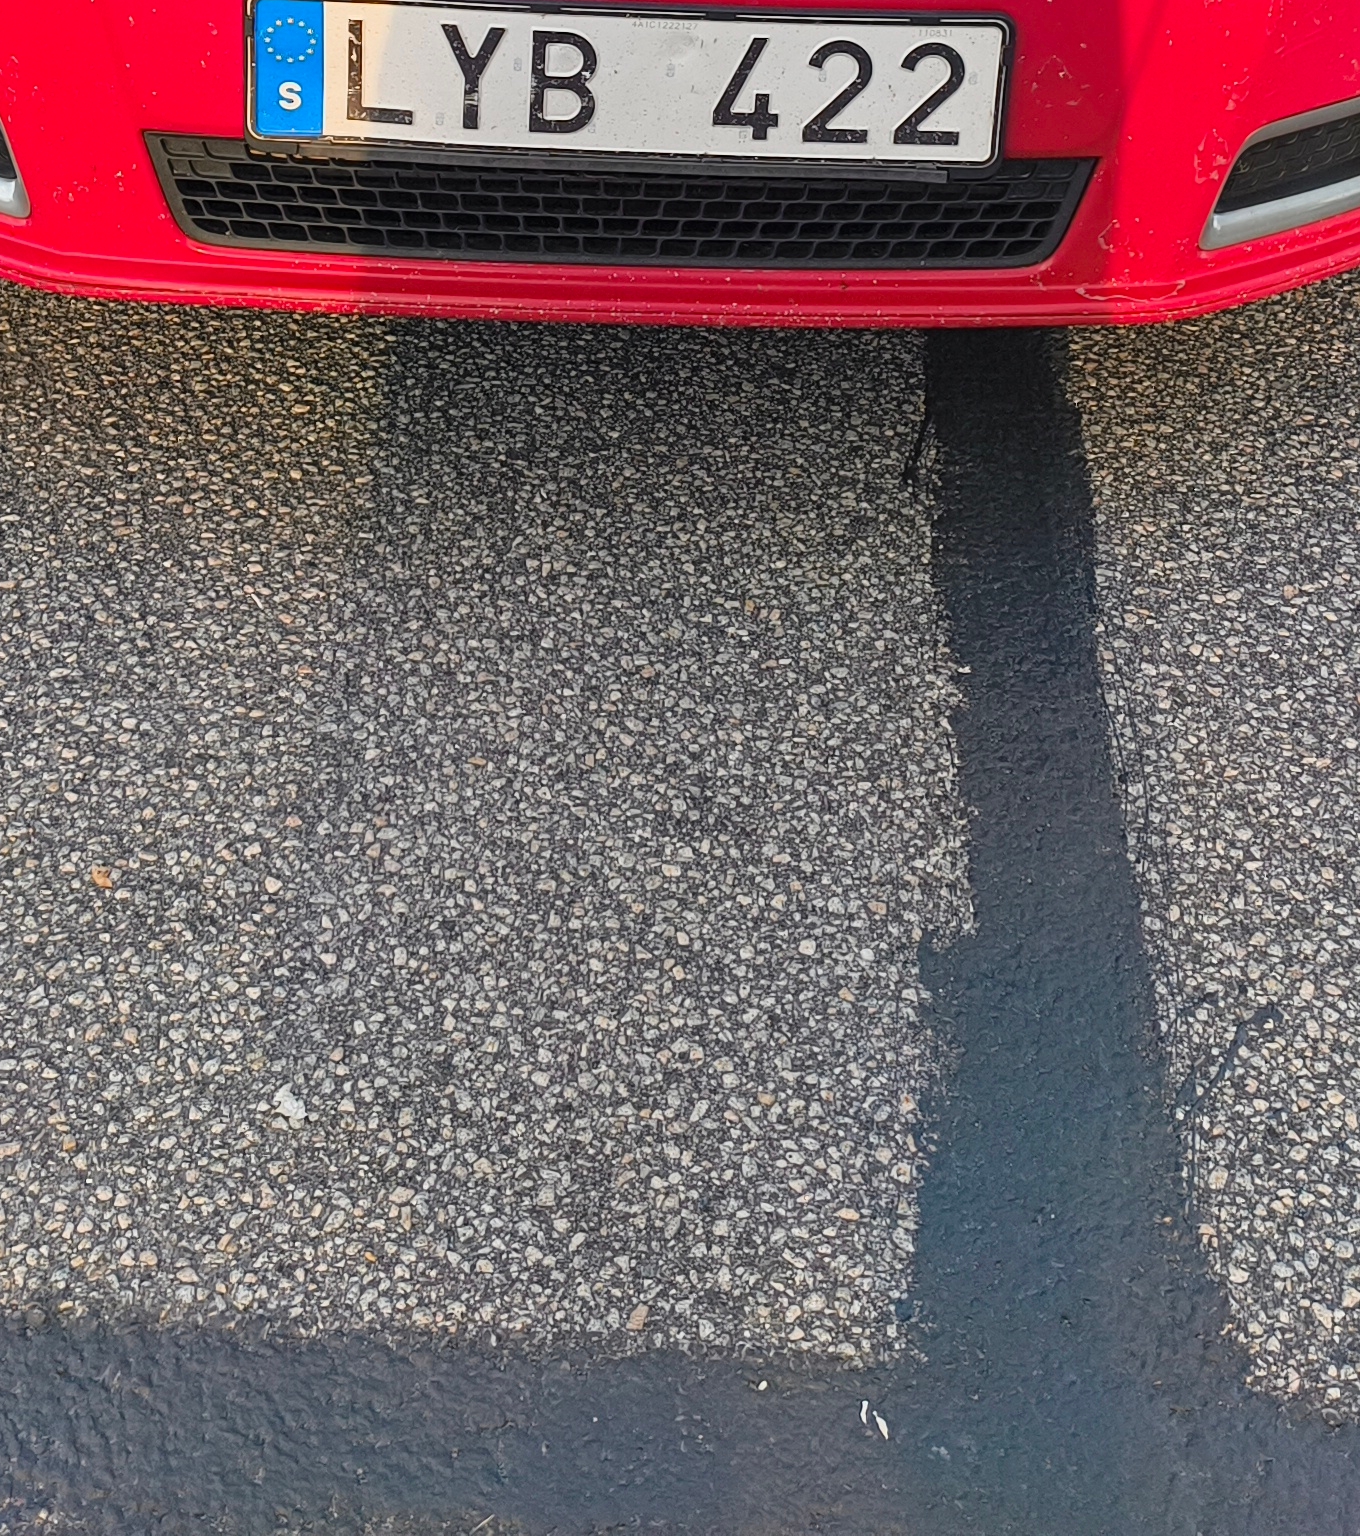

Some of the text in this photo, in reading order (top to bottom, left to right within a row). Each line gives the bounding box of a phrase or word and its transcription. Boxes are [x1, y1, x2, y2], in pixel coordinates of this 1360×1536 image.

[278, 81, 303, 111] S
[346, 19, 966, 146] LYB 422
